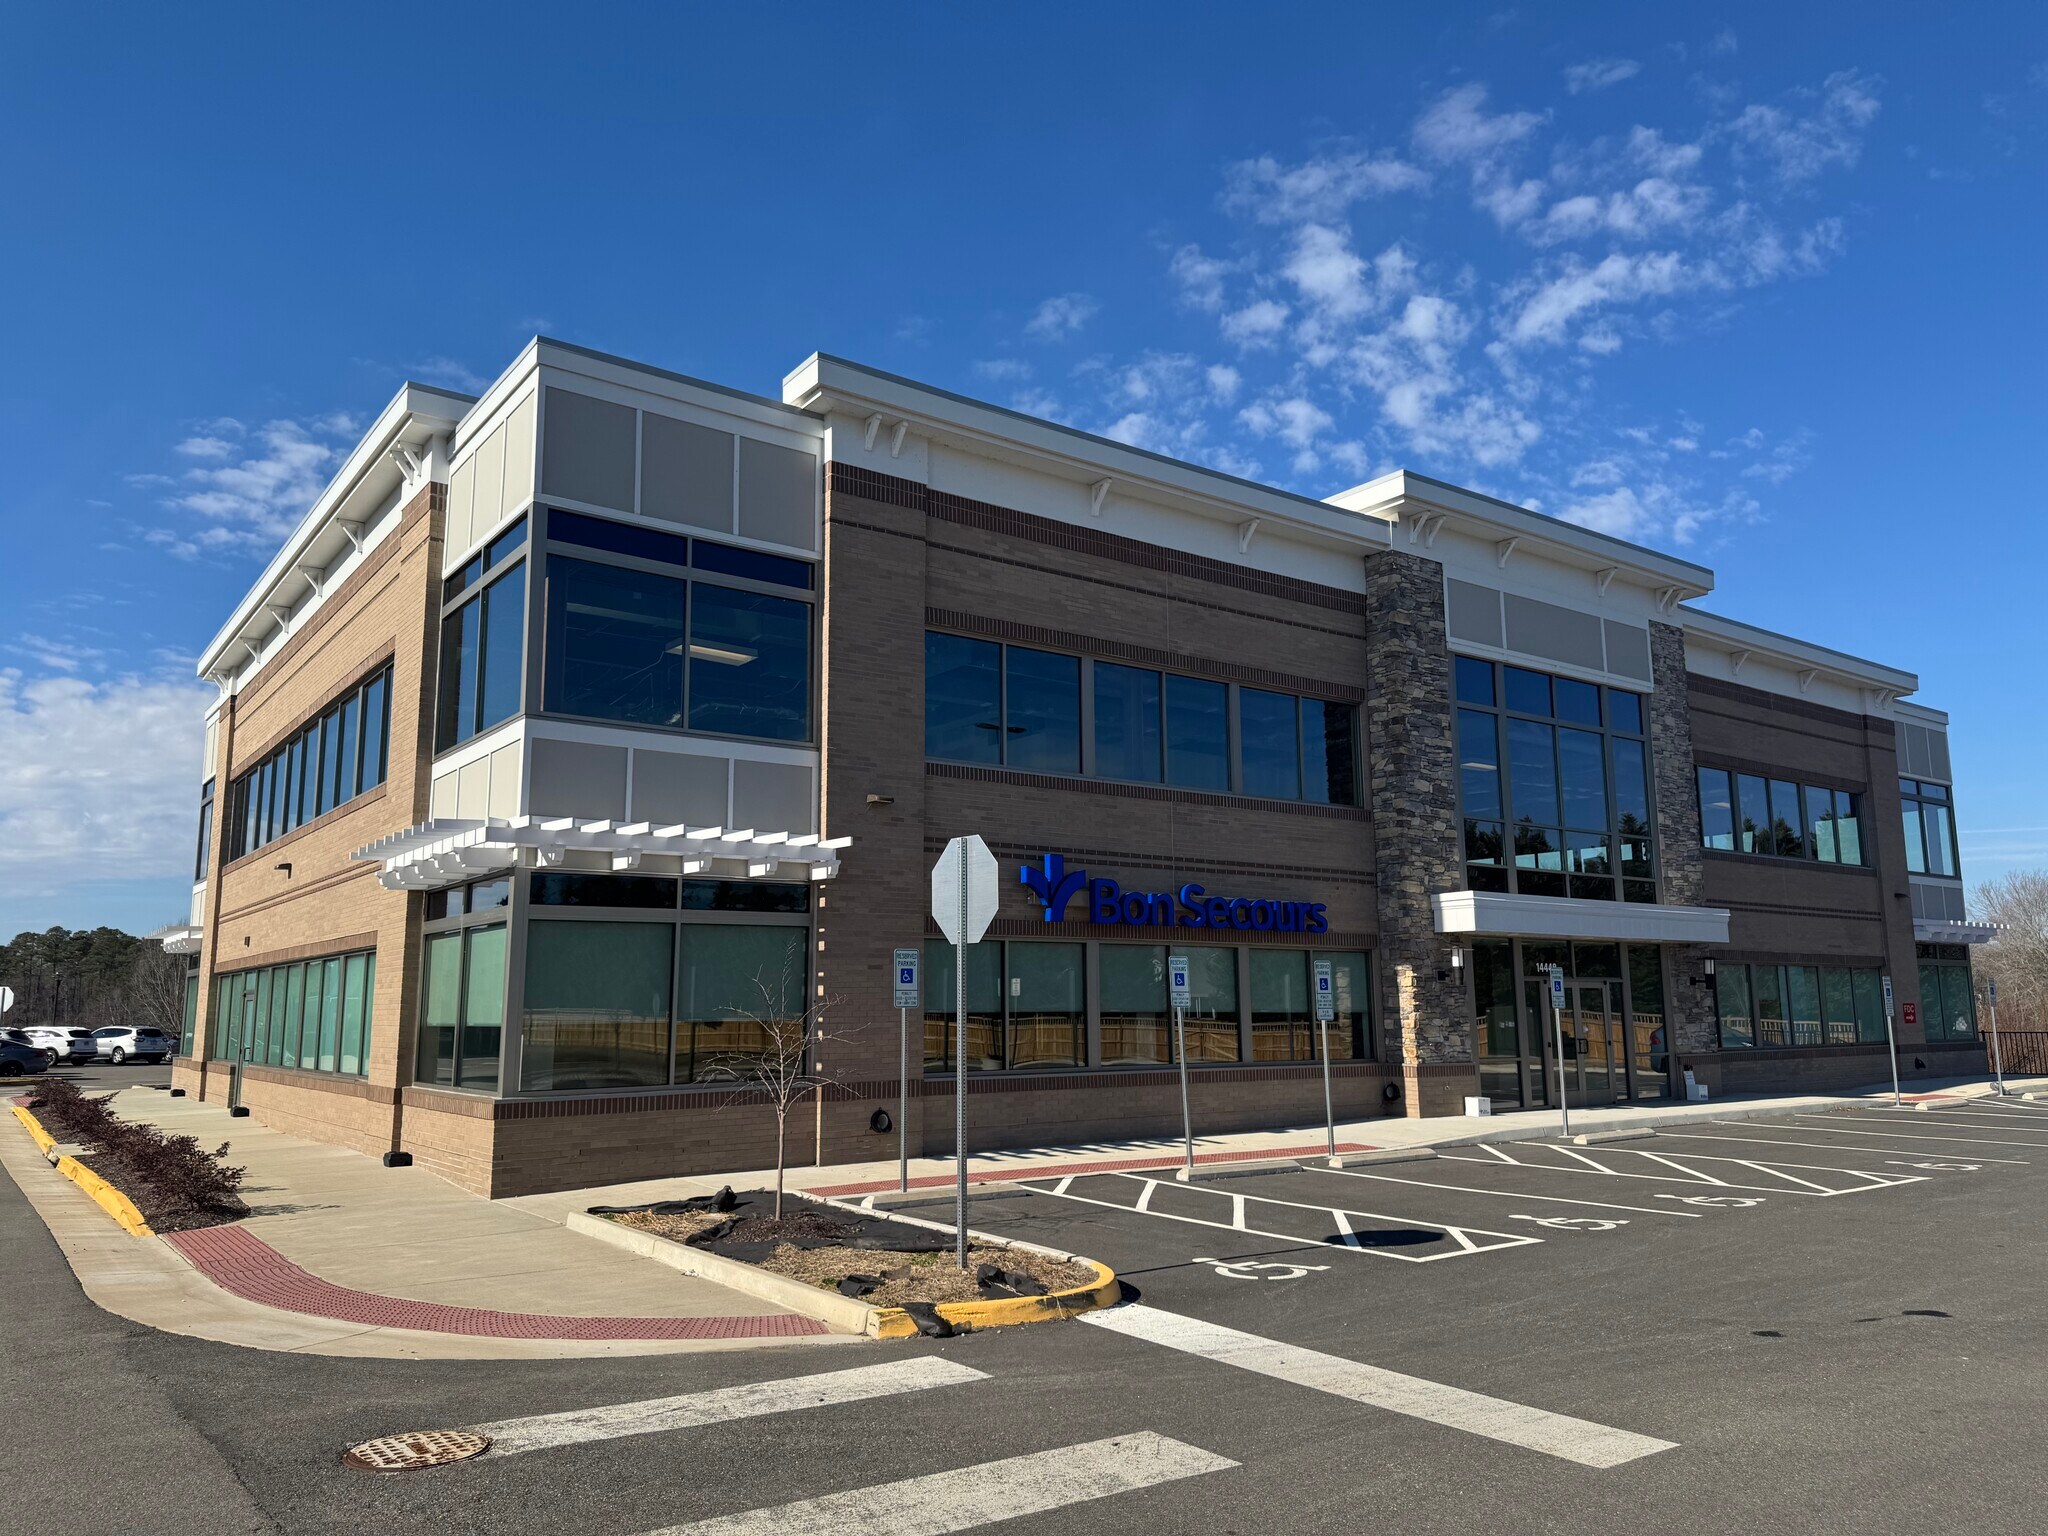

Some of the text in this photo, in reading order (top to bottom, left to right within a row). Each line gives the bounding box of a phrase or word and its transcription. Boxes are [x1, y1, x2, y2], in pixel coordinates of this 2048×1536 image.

[1089, 878, 1328, 934] Bon Secours
[1903, 1004, 1915, 1013] FDC
